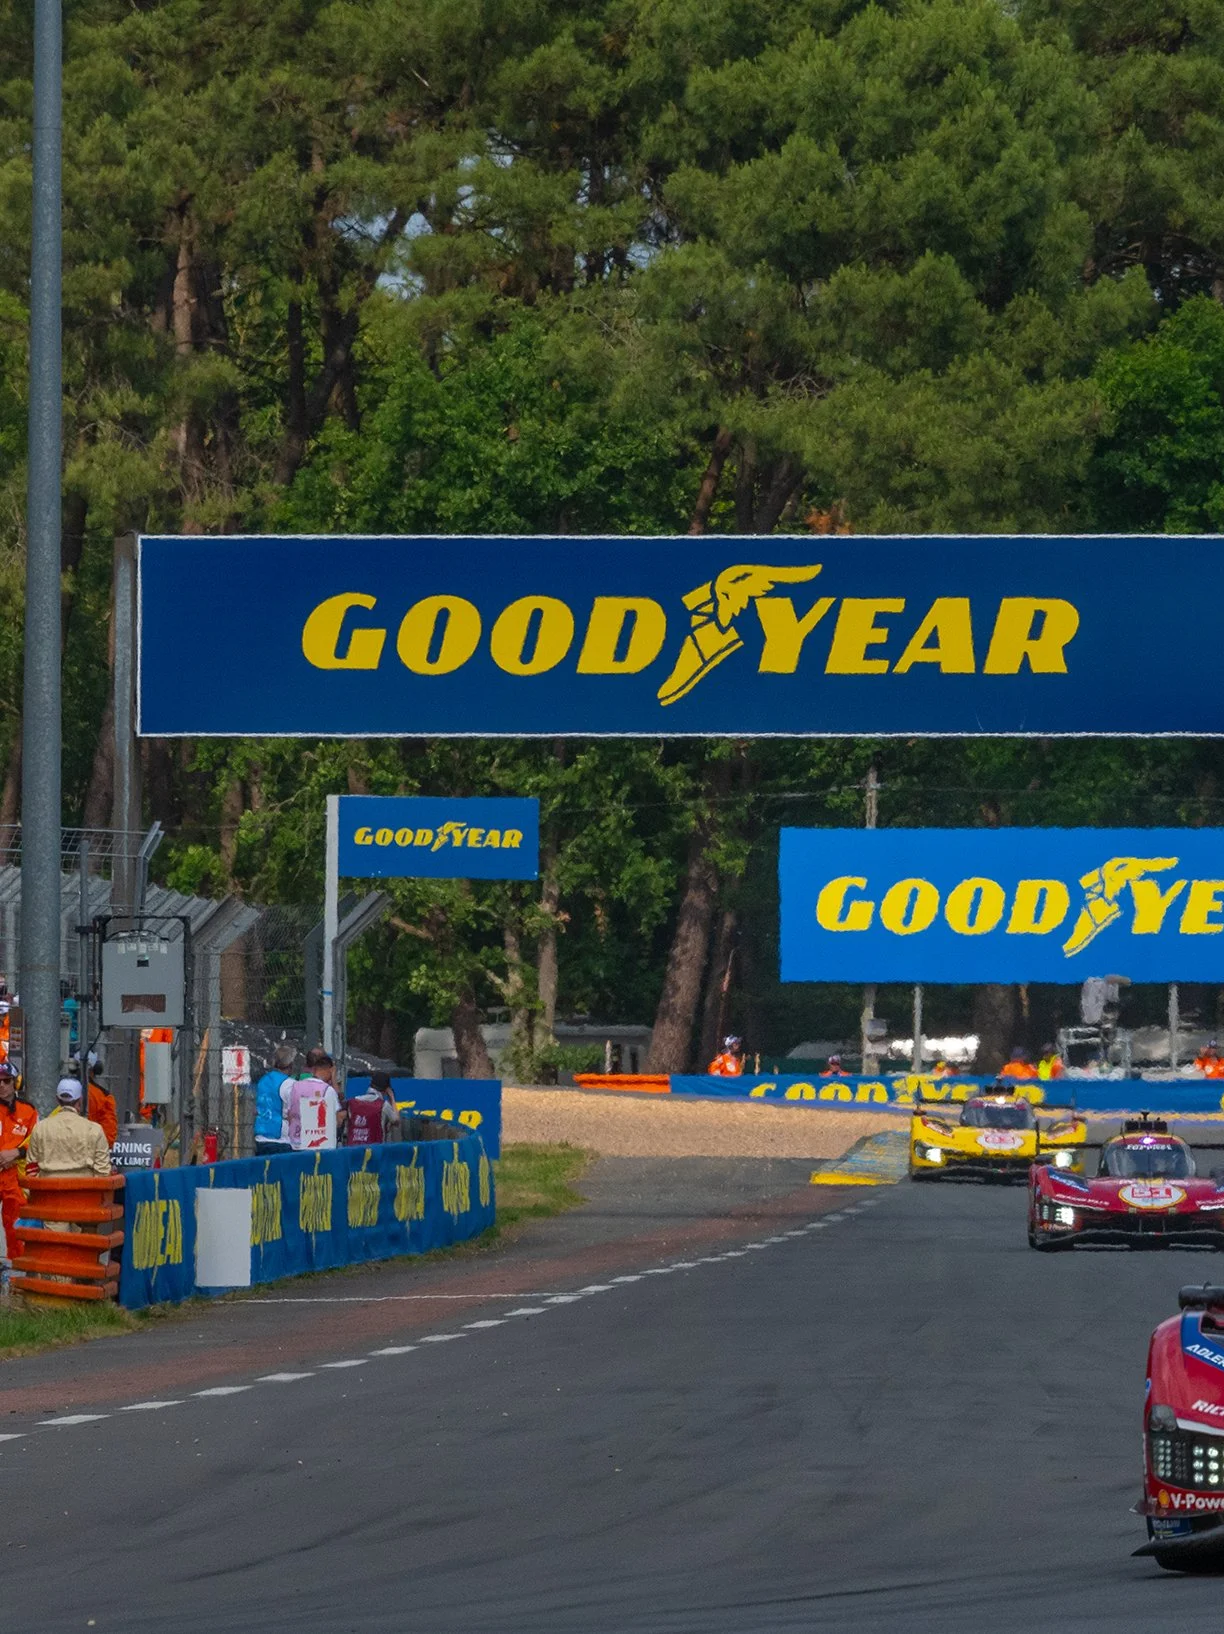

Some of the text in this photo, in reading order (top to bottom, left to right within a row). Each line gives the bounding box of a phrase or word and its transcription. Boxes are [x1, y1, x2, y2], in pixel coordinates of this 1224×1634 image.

[301, 590, 1081, 678] GOODYEAR
[354, 826, 524, 849] GOODYEAR
[110, 1142, 153, 1154] RNING
